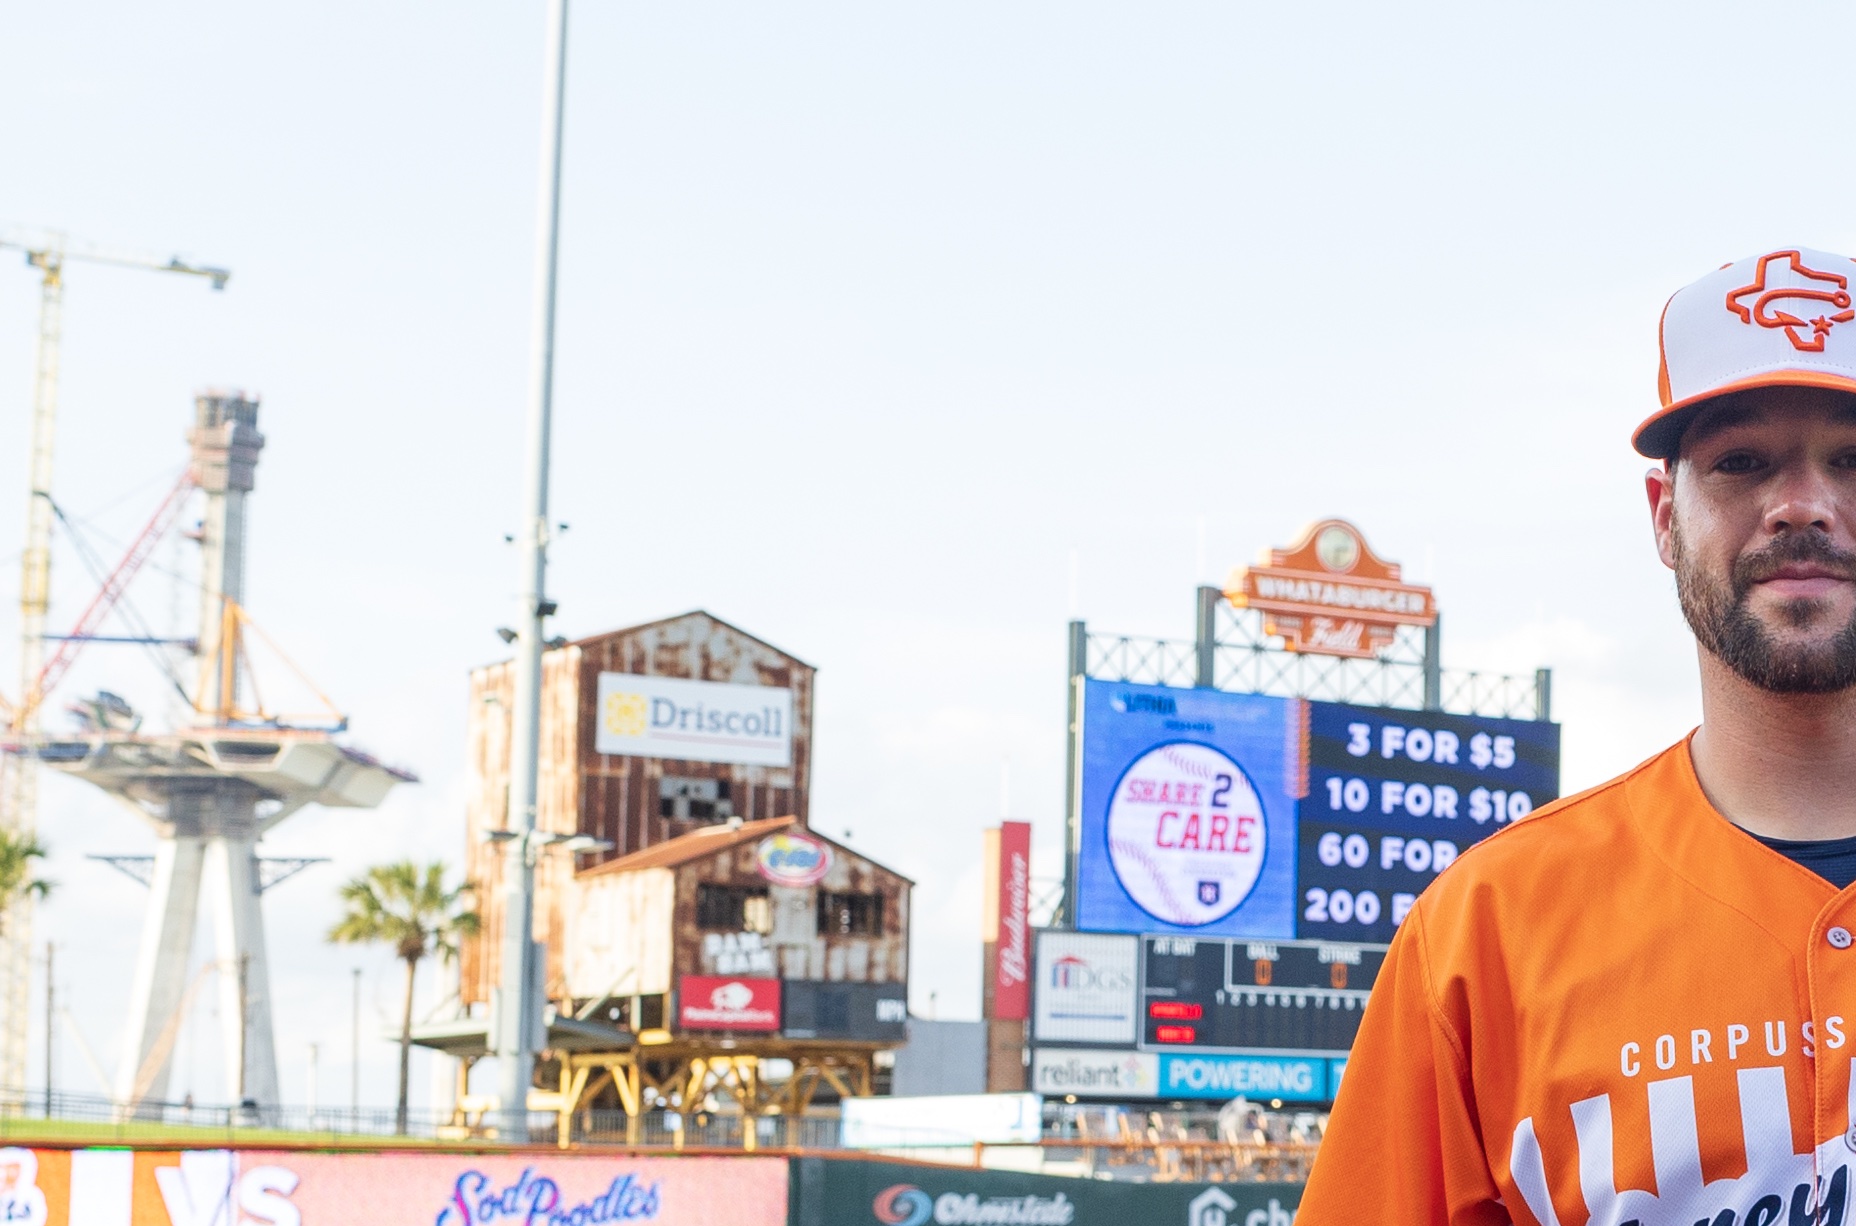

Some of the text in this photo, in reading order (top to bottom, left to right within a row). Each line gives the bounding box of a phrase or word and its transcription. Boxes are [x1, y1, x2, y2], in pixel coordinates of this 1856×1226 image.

[1256, 575, 1426, 615] WHATABURGER
[1309, 616, 1364, 651] Field
[650, 696, 783, 738] Driscoll
[1347, 723, 1516, 770] 3 FOR $5
[1127, 773, 1232, 808] SHARE 2
[1325, 776, 1533, 825] 10 FOR $10
[1156, 811, 1256, 853] CARE
[1318, 832, 1459, 873] 60 FOR
[1304, 887, 1381, 925] 200
[1039, 1057, 1120, 1088] reliant
[1168, 1059, 1312, 1093] POWERING
